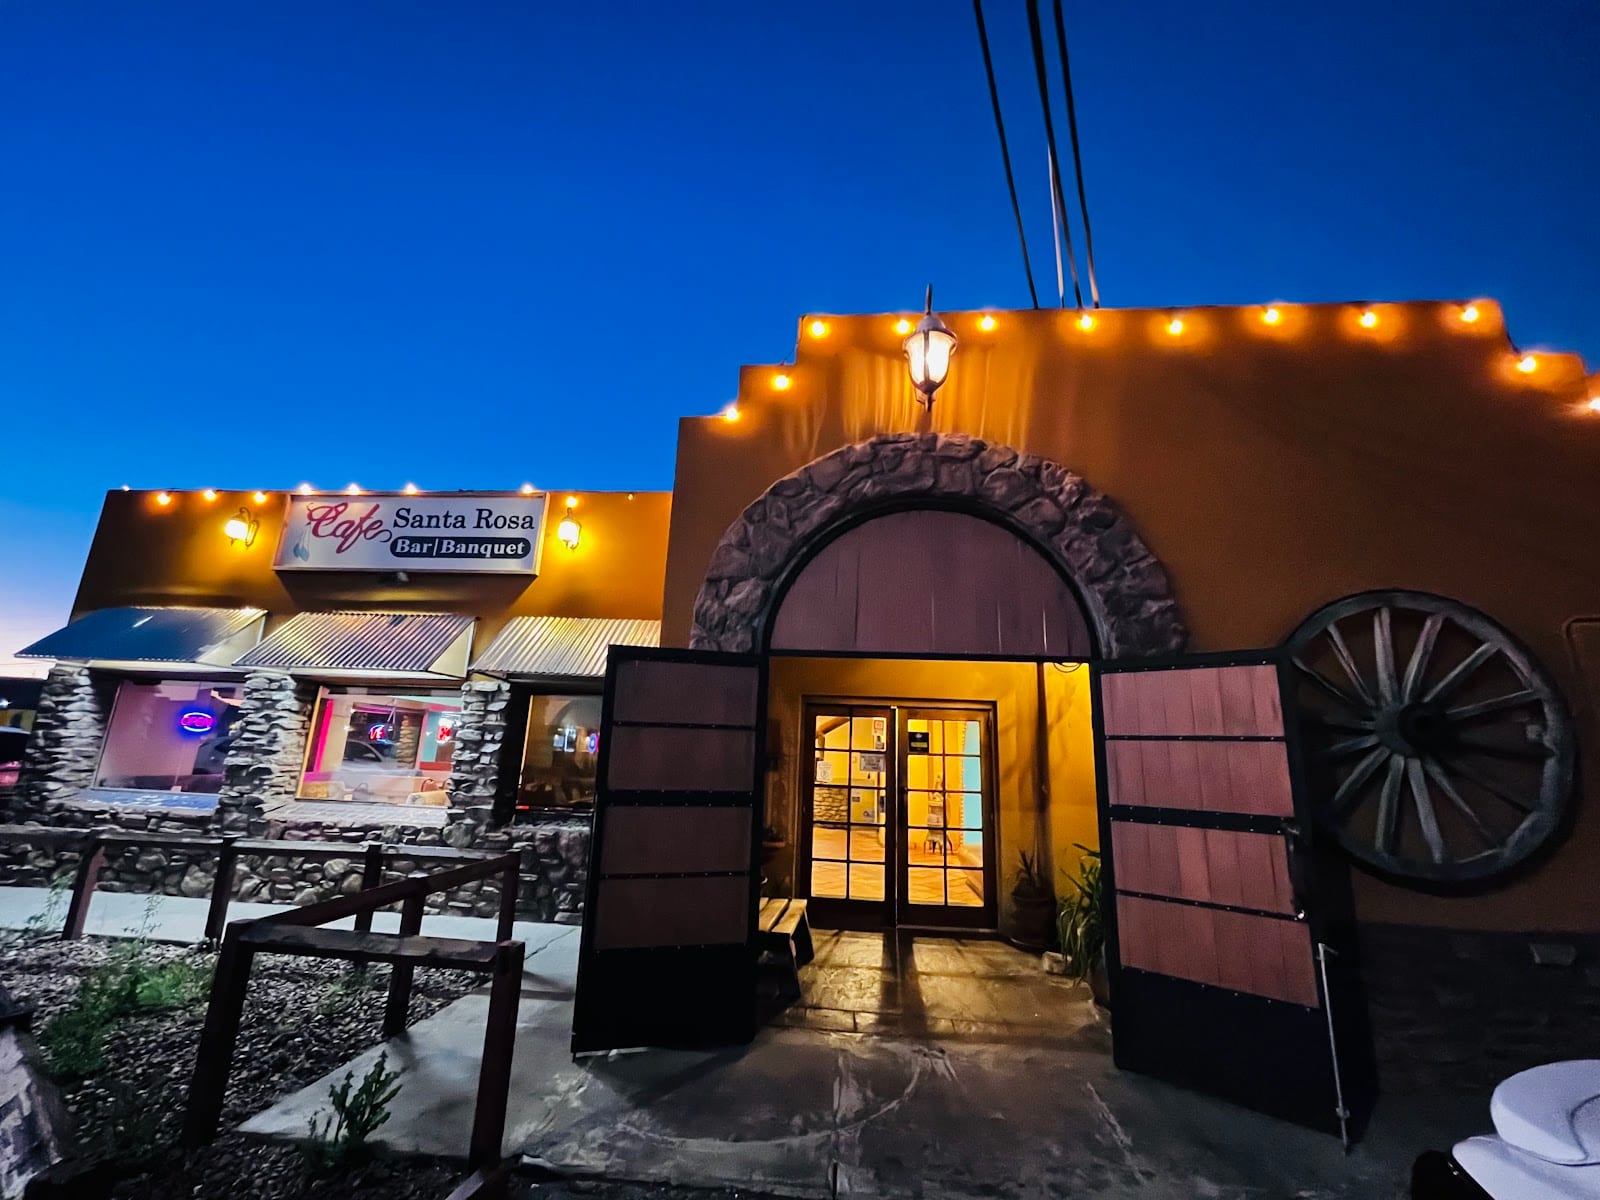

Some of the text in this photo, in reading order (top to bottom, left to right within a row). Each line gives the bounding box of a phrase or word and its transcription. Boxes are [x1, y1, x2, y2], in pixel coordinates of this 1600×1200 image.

[307, 502, 392, 554] Cafe
[393, 508, 535, 530] Santa Rosa
[180, 716, 213, 727] OPEN
